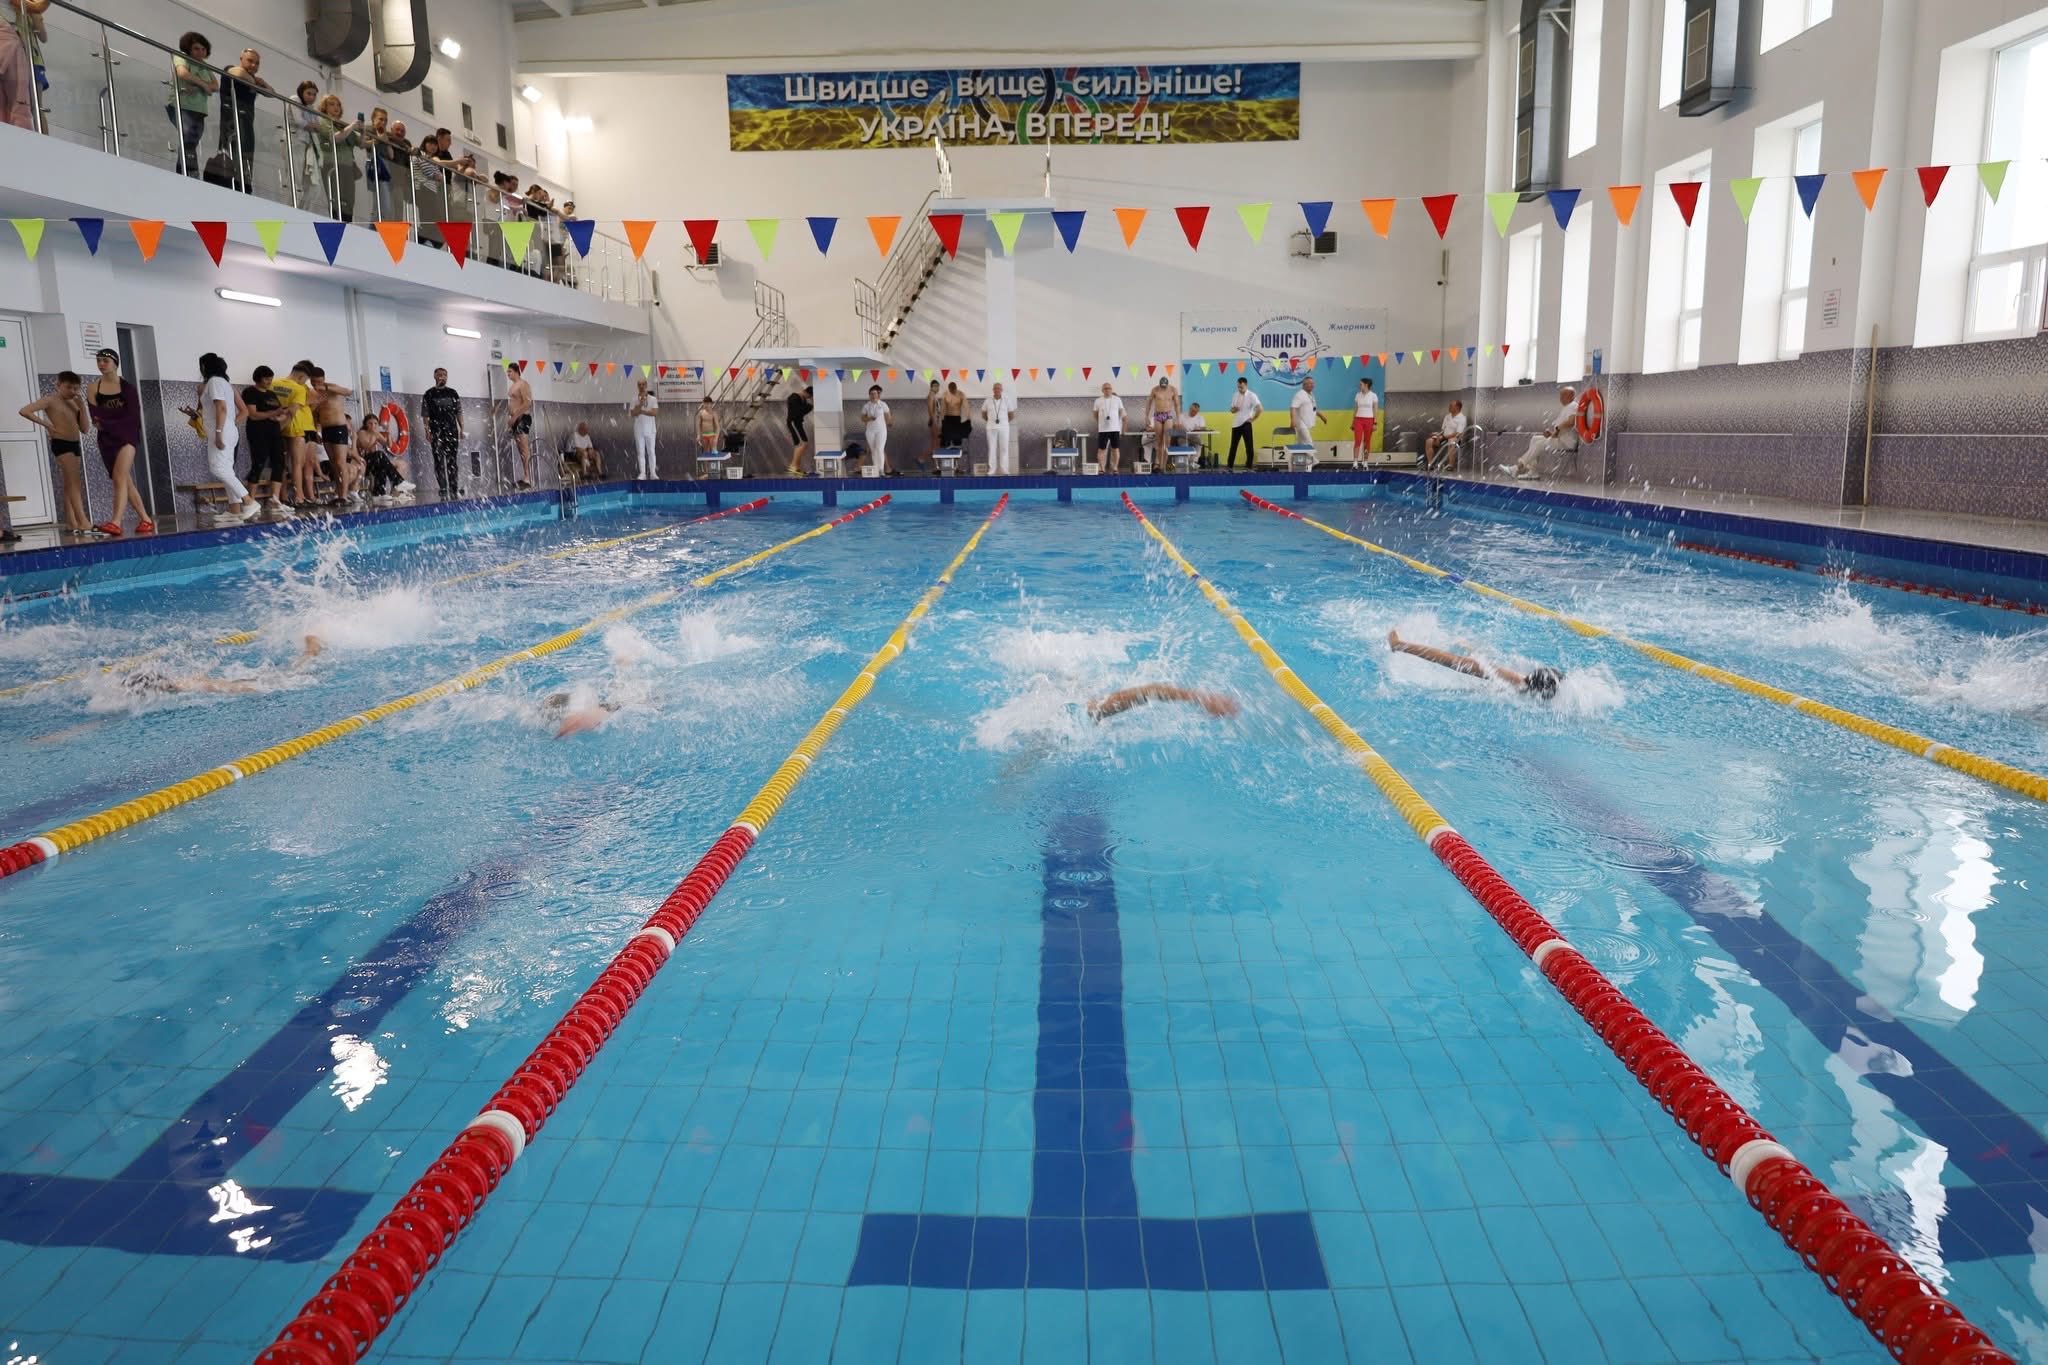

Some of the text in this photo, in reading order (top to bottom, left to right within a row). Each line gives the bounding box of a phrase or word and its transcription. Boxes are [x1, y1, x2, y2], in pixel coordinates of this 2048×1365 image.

[1072, 67, 1242, 96] сильніше!
[857, 108, 1170, 143] УКРАЇНА, ВПЕРЕД!
[1260, 333, 1307, 349] ЮНІСТЬ
[1278, 451, 1286, 460] 2
[1330, 445, 1338, 457] 1
[1386, 454, 1392, 462] 3
